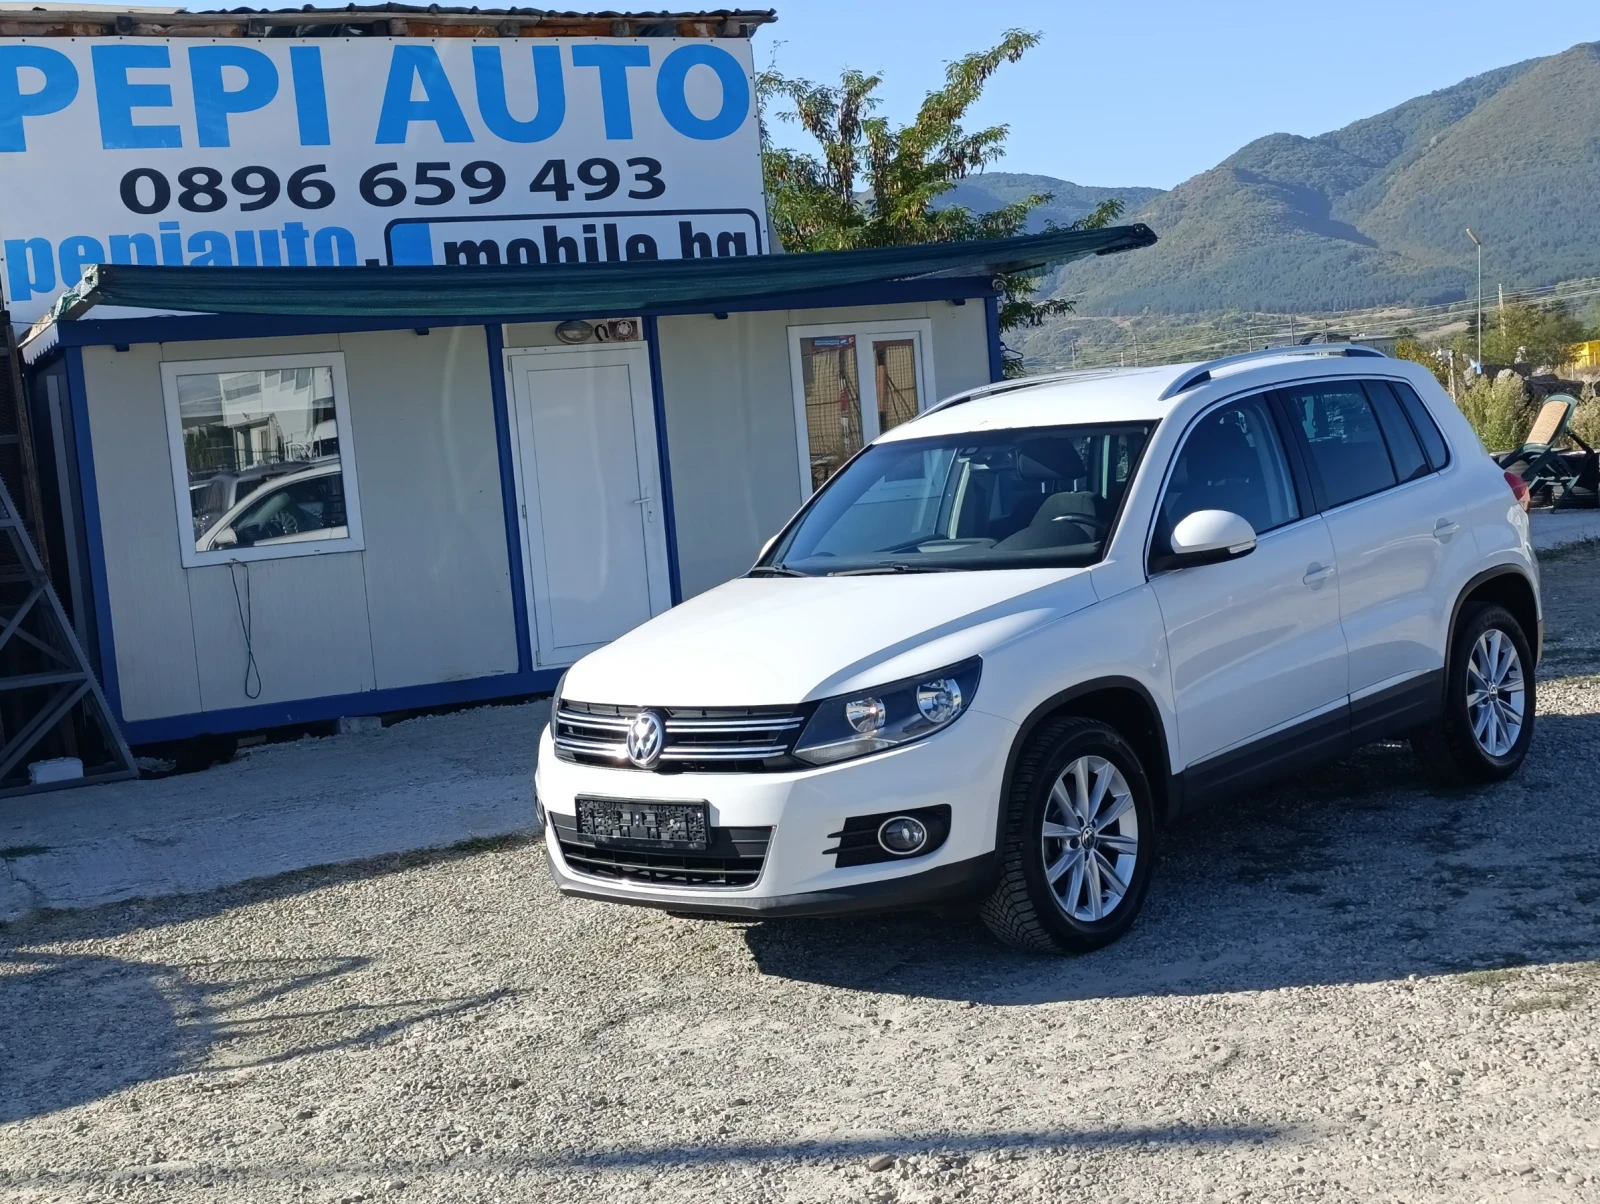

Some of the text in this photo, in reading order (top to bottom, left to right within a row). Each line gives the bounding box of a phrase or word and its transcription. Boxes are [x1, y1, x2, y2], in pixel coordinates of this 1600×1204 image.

[0, 44, 750, 152] PEPI AUTO
[119, 156, 666, 215] 0896 659 493
